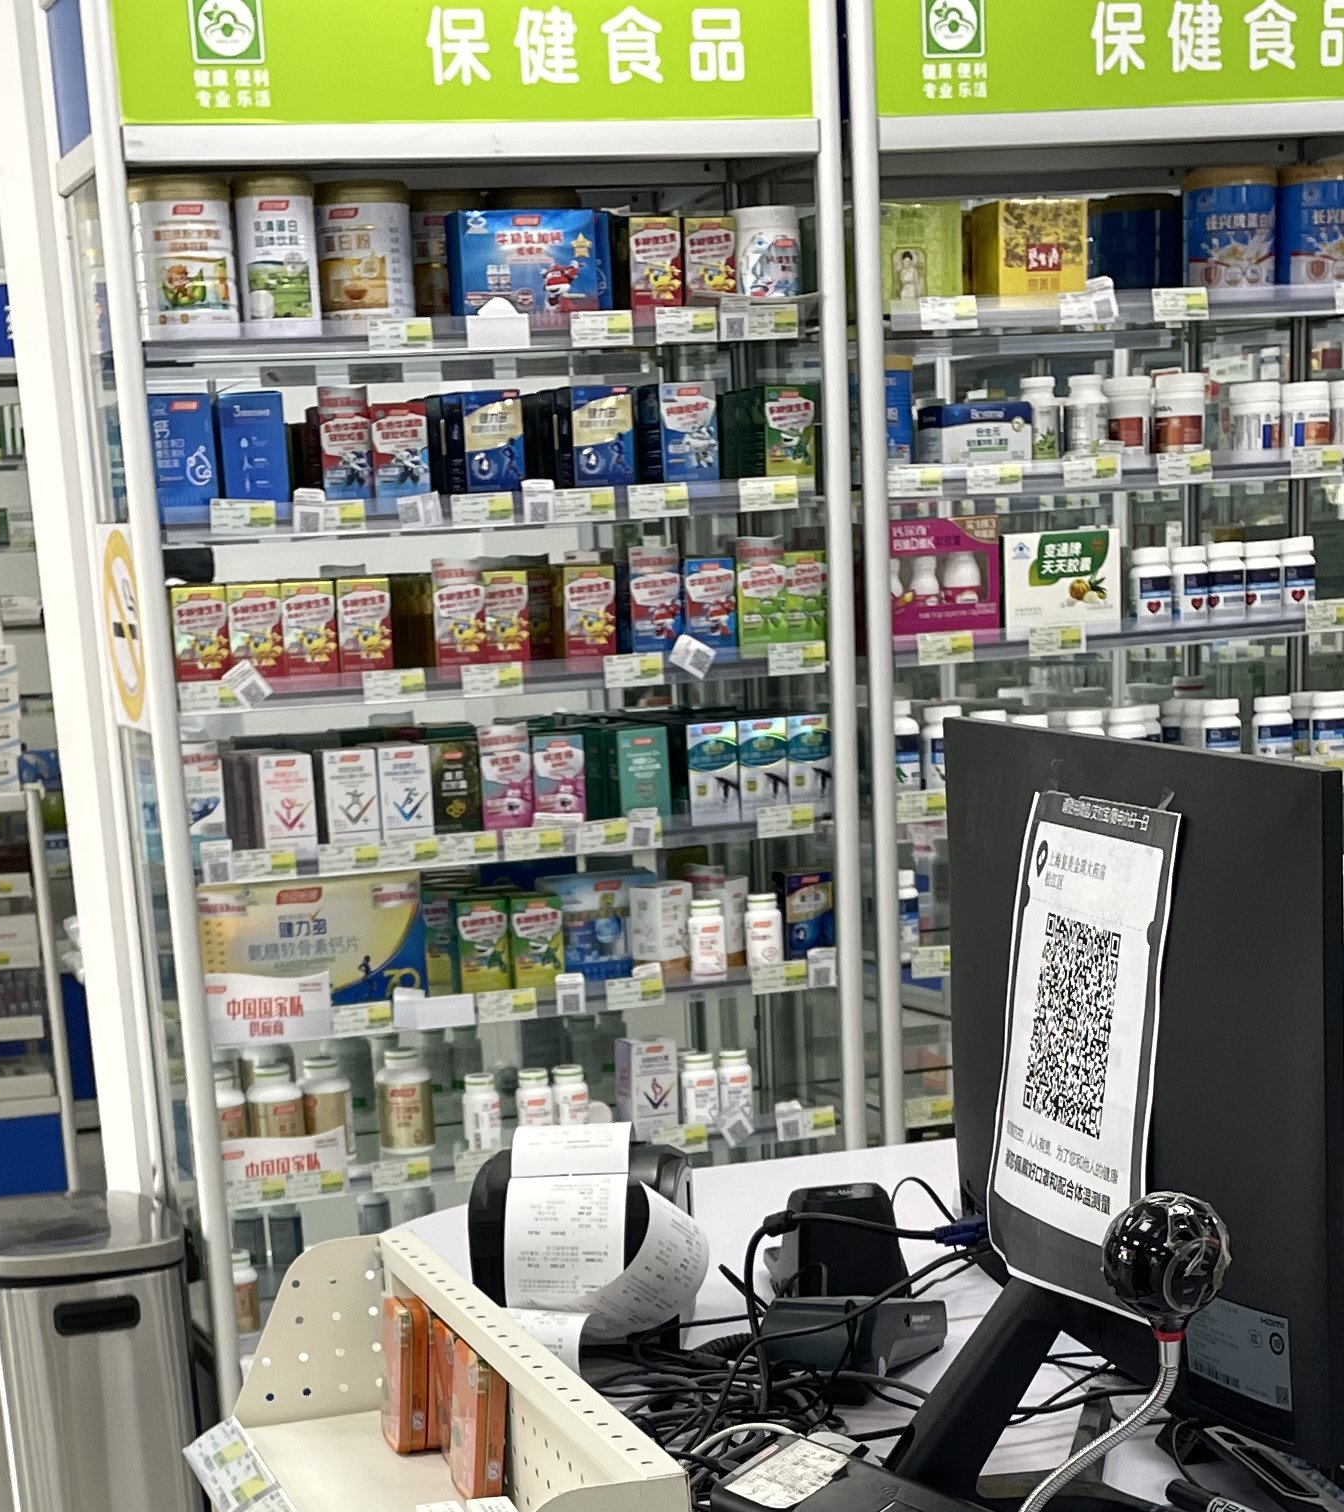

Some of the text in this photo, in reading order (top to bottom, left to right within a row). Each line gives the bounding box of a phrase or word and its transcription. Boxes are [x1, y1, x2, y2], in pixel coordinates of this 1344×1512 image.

[426, 6, 747, 86] 保健食品
[277, 920, 329, 939] 健力多
[225, 994, 305, 1022] 中国国家队
[248, 1021, 286, 1039] 供应商
[244, 1152, 322, 1180] 中国国家队
